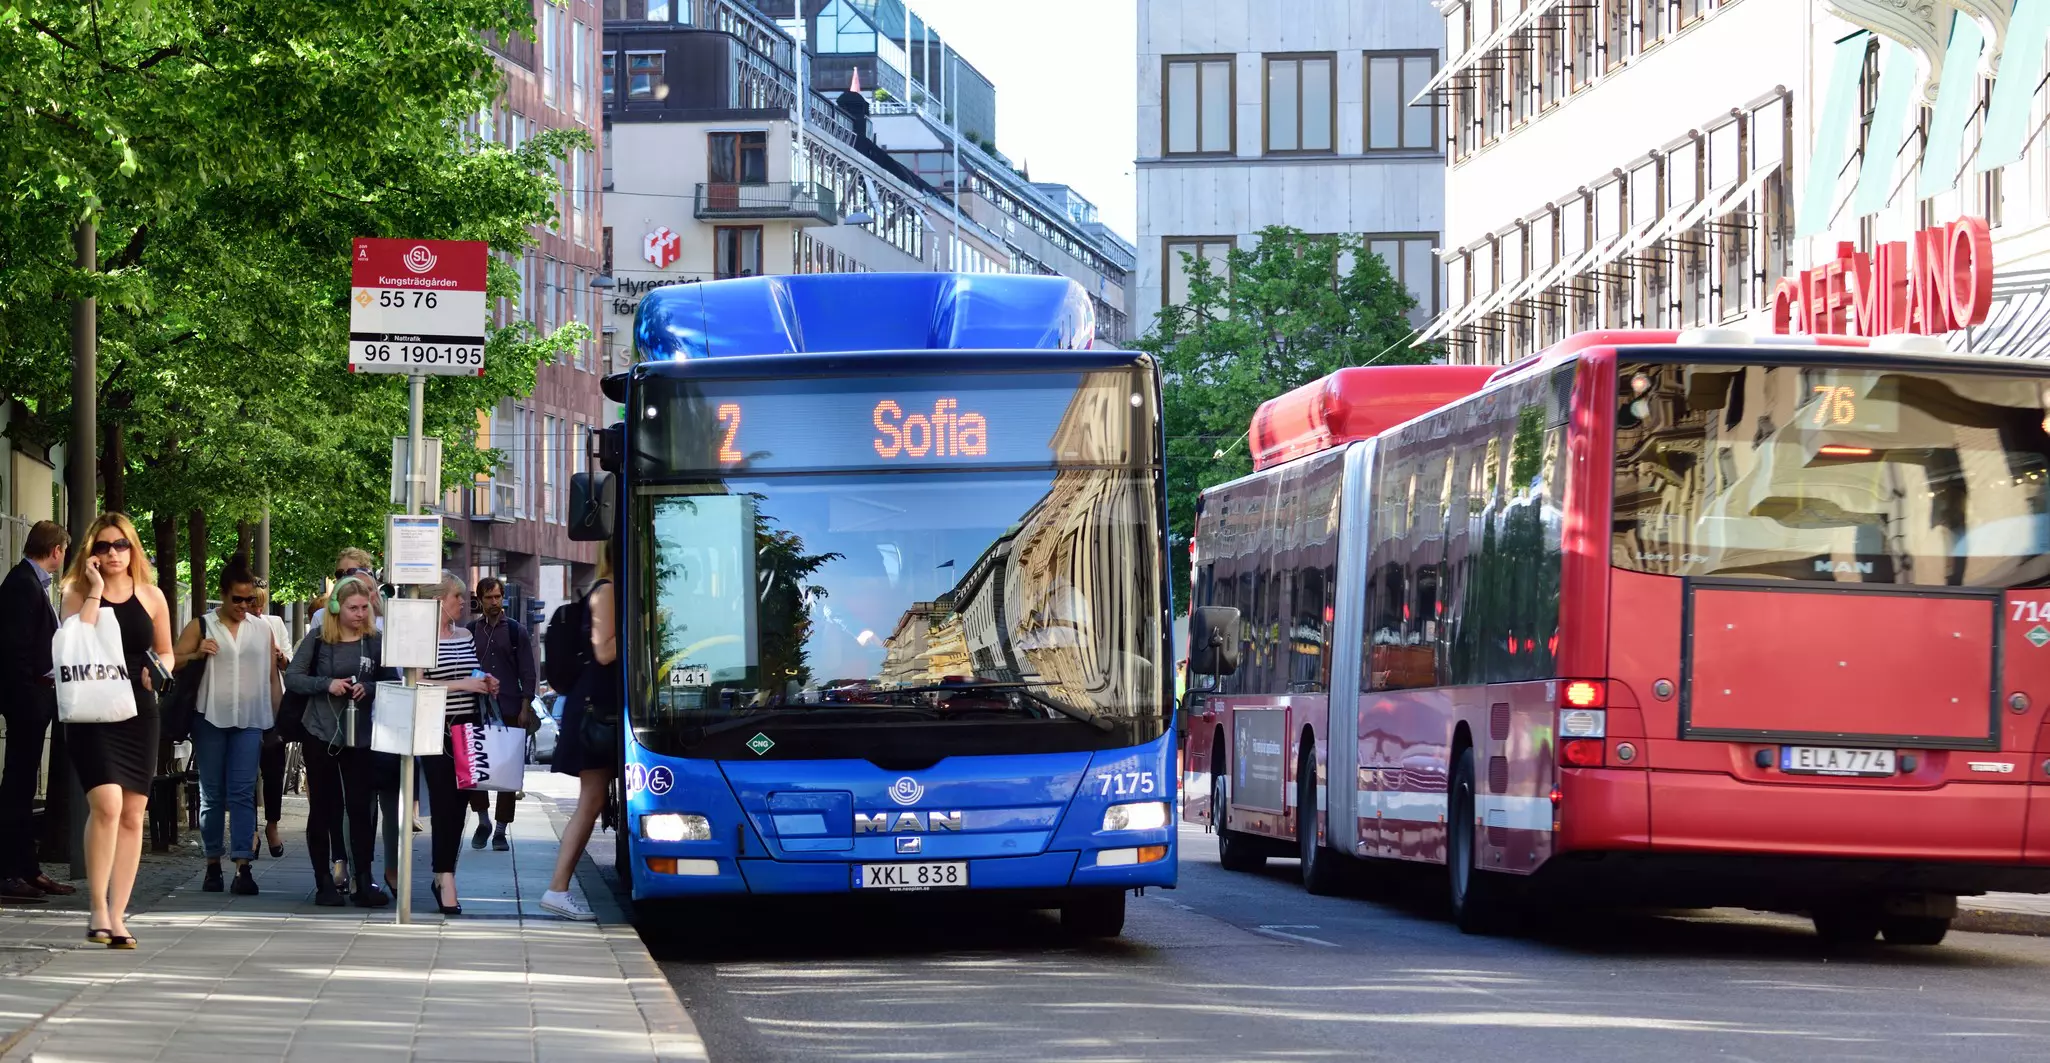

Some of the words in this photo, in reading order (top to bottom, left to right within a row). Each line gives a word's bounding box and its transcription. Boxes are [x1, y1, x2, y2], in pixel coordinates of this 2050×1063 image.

[359, 249, 367, 258] A
[413, 250, 429, 261] SL
[379, 276, 458, 287] Kungsträdgården
[1852, 215, 1993, 336] MILANO
[617, 276, 702, 297] Hyres
[361, 296, 367, 304] 2
[380, 291, 404, 307] 55
[413, 292, 437, 308] 76
[364, 344, 390, 361] 96
[401, 346, 481, 364] 190-195
[1812, 385, 1855, 424] 76
[719, 403, 742, 461] 2
[873, 398, 987, 458] Sofia
[1814, 559, 1873, 573] MAN
[464, 722, 476, 755] DESIGN
[752, 740, 769, 748] CNG
[473, 724, 490, 782] MoMA
[1800, 748, 1839, 769] ELA
[1846, 750, 1887, 770] 774
[467, 755, 478, 785] STORE
[899, 782, 915, 793] SL
[1098, 772, 1155, 796] 7175
[854, 811, 962, 833] MAN
[870, 866, 910, 885] XKL
[917, 865, 958, 884] 838
